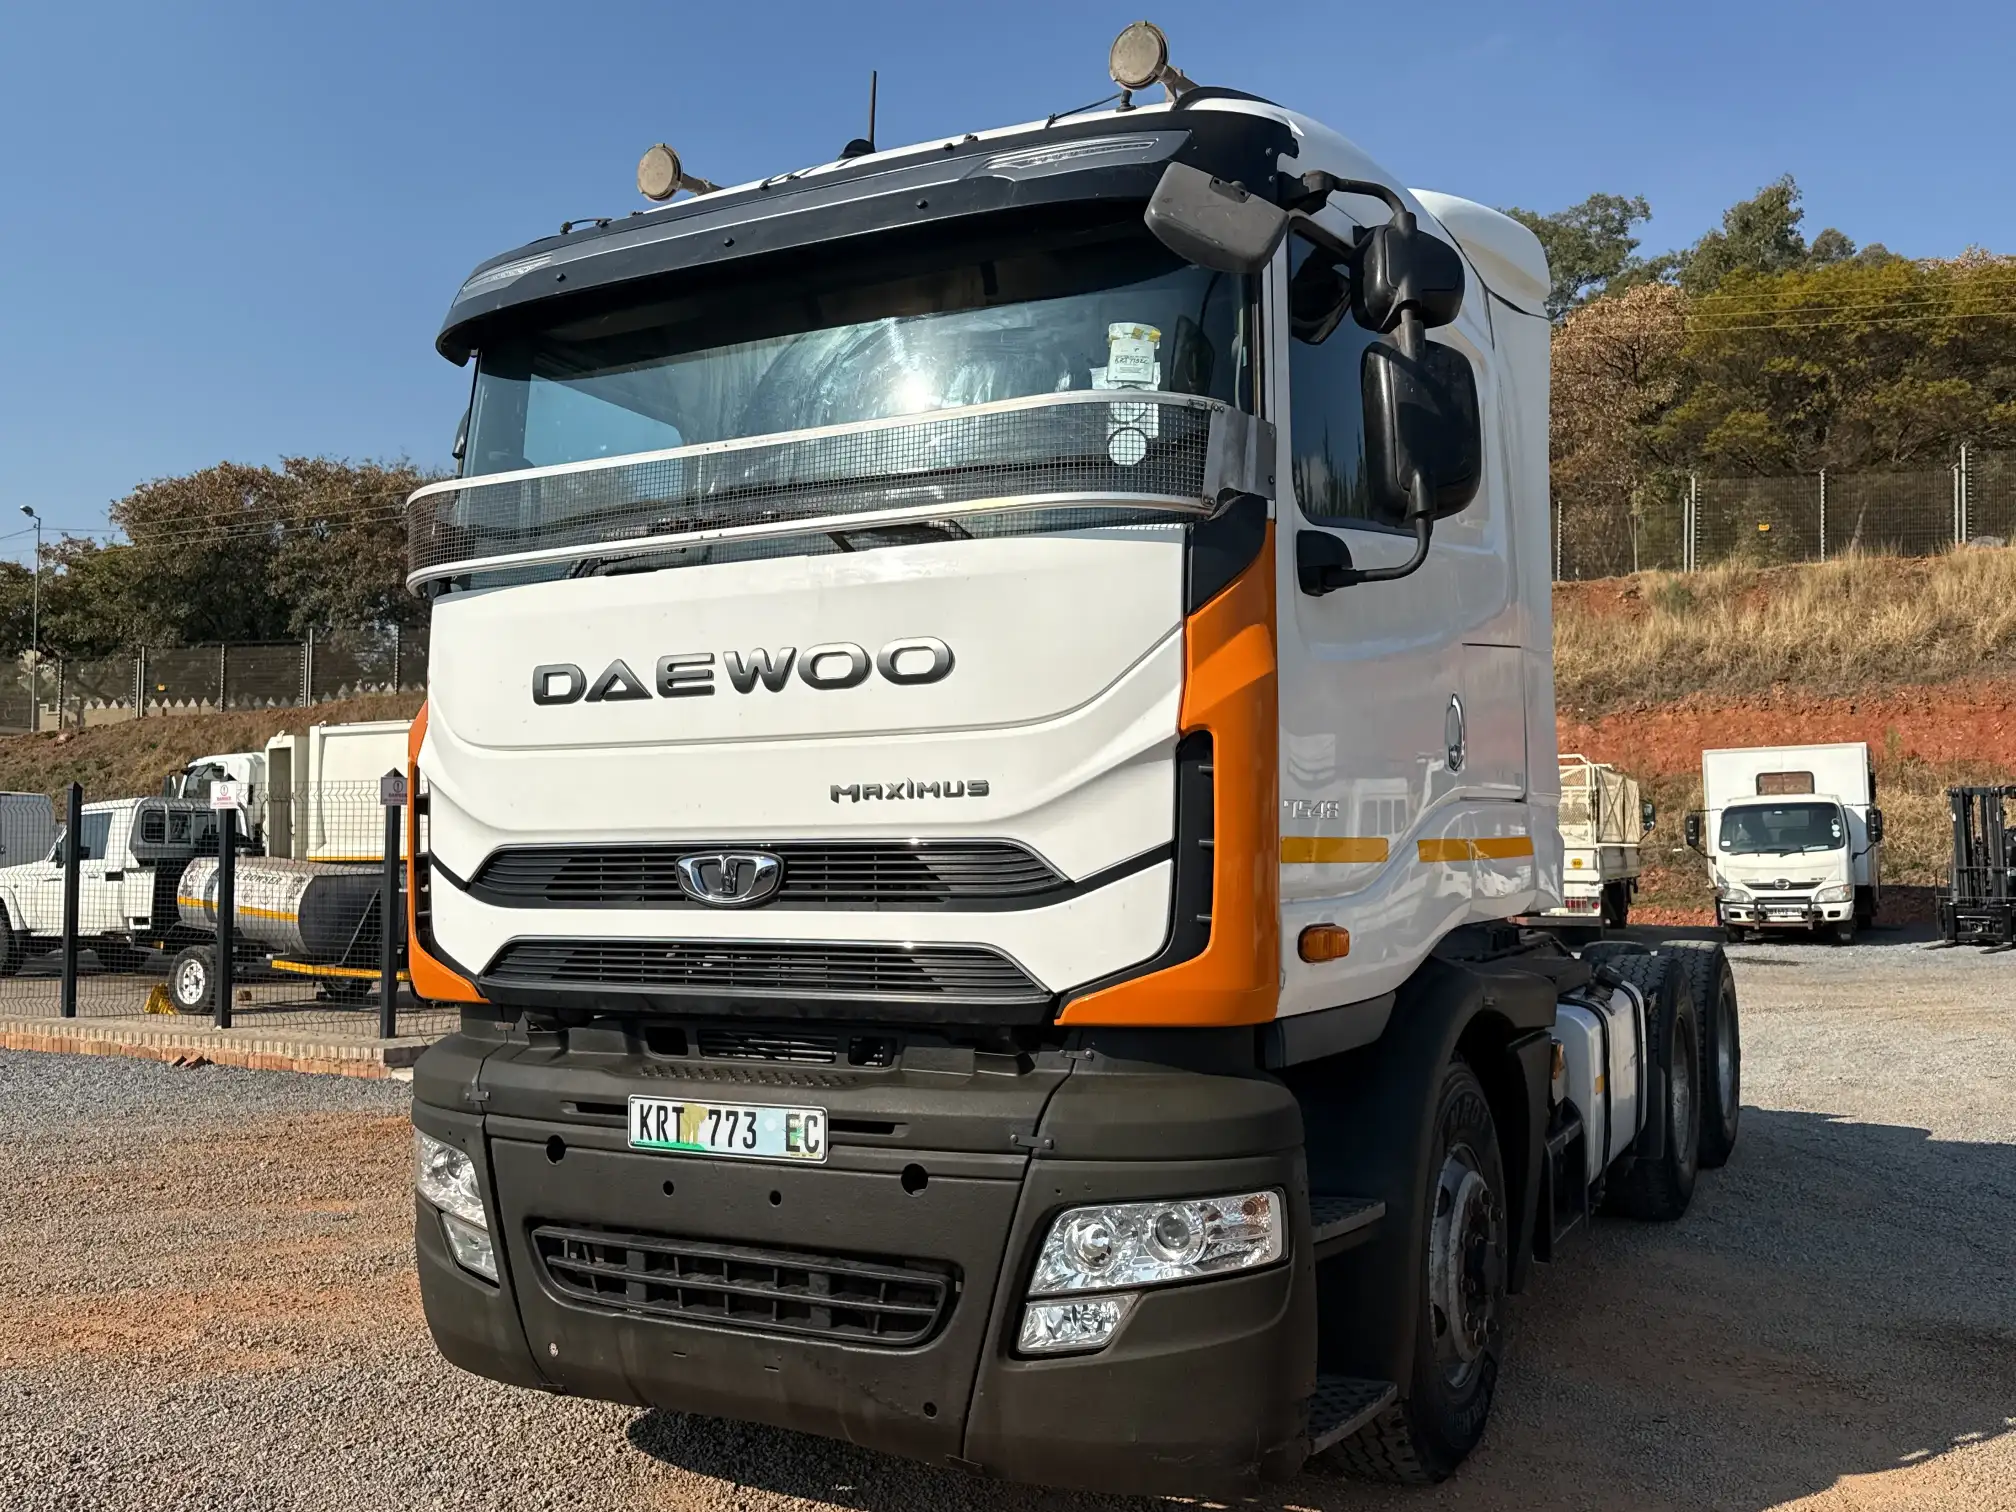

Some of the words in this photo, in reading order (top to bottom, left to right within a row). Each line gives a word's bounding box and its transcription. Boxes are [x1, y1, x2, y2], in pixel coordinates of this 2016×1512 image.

[533, 636, 955, 706] DAEWOO
[830, 777, 989, 804] MAXIMUS
[1283, 799, 1339, 819] 7548
[243, 873, 283, 885] BOWSER
[639, 1104, 685, 1144] KRT
[708, 1109, 757, 1150] 773
[785, 1113, 820, 1154] EC
